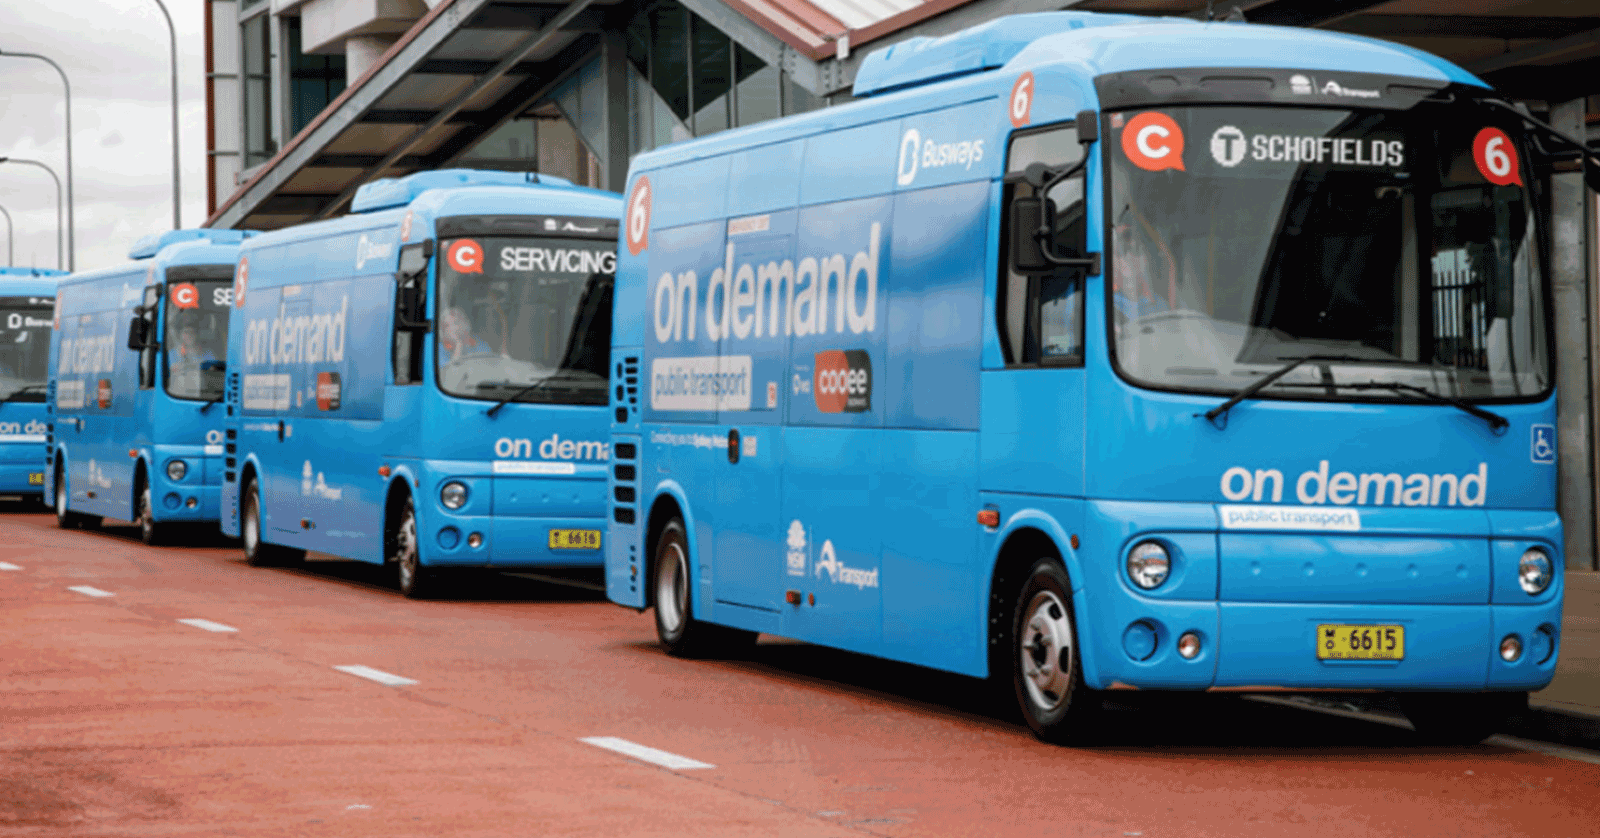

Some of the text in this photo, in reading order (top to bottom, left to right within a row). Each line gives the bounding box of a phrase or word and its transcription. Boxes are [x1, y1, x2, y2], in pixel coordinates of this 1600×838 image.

[1013, 78, 1030, 120] 6
[922, 138, 985, 171] Busways
[1136, 124, 1171, 159] C
[1252, 134, 1404, 167] SCHOFIELDS
[1485, 136, 1510, 177] 6
[630, 185, 647, 244] 6
[455, 246, 476, 267] C
[500, 247, 616, 274] SERVICING
[177, 288, 192, 304] C
[654, 221, 882, 344] on demand
[246, 295, 348, 365] on demand
[818, 367, 868, 396] cooee
[494, 437, 532, 458] on
[1220, 459, 1488, 506] on demand
[1228, 508, 1355, 528] public transport
[1349, 629, 1396, 651] 6615
